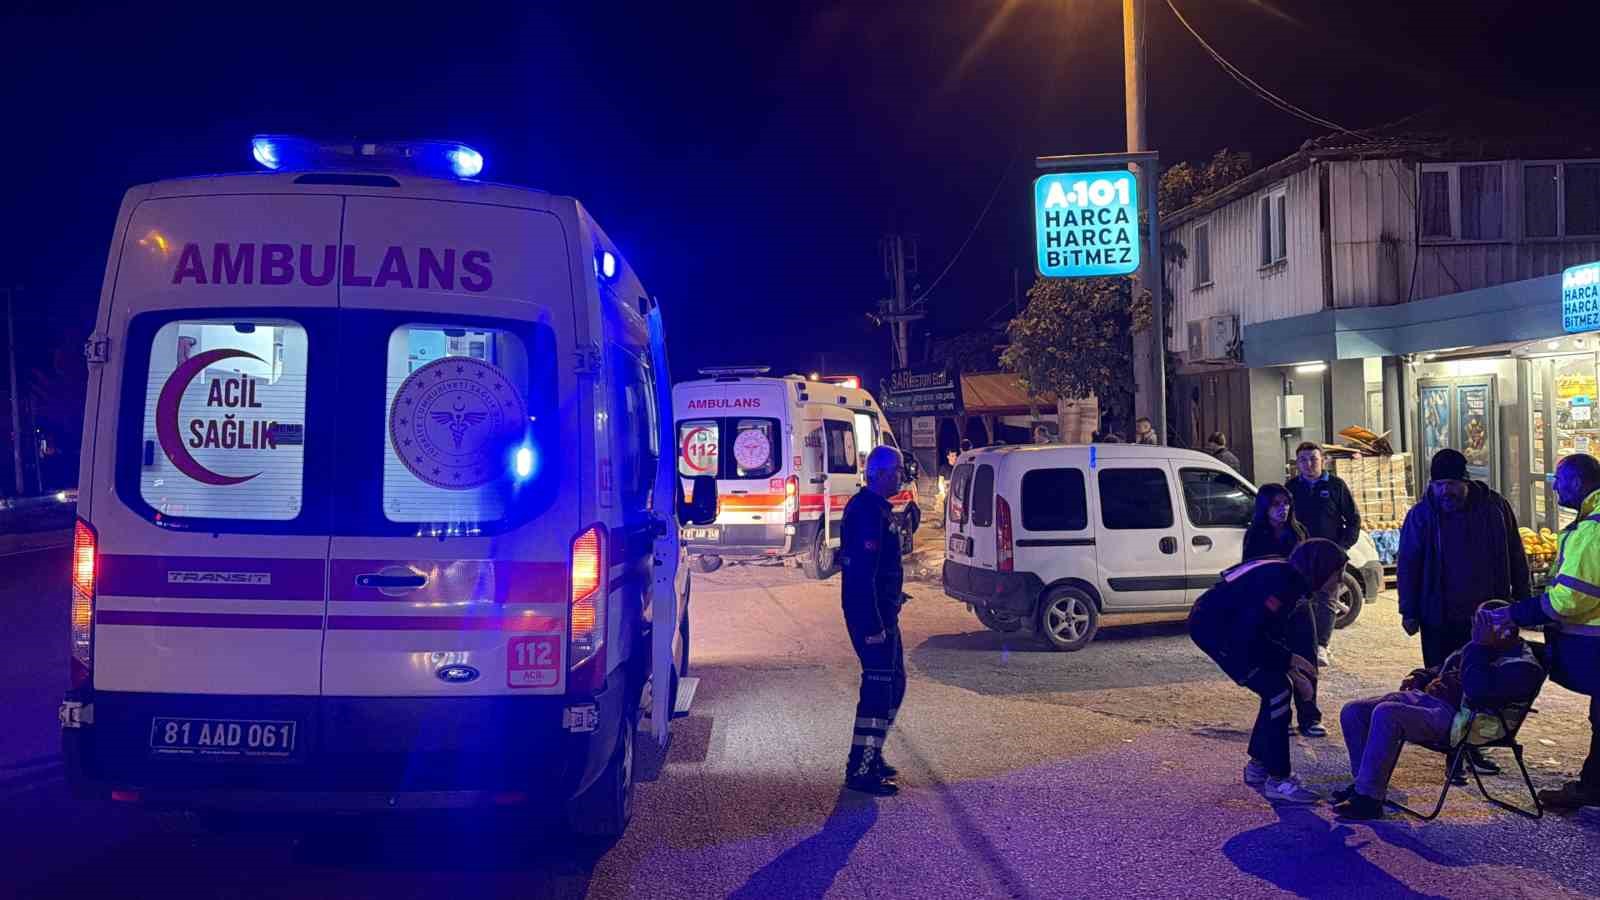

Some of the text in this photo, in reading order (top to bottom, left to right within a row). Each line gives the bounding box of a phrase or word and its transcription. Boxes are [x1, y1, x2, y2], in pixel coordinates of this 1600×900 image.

[1045, 207, 1129, 228] HARCA
[1046, 228, 1130, 248] HARCA
[172, 243, 493, 292] AMBULANS
[1564, 285, 1598, 301] HARCA
[1564, 299, 1598, 315] HARCA
[207, 373, 262, 408] ACİL
[688, 398, 761, 409] AMBULANS
[189, 413, 277, 450] SAĞLIK
[690, 443, 717, 457] 112
[168, 572, 269, 584] TRANSIT
[515, 641, 552, 666] 112
[164, 722, 289, 748] 81 AAD 061
